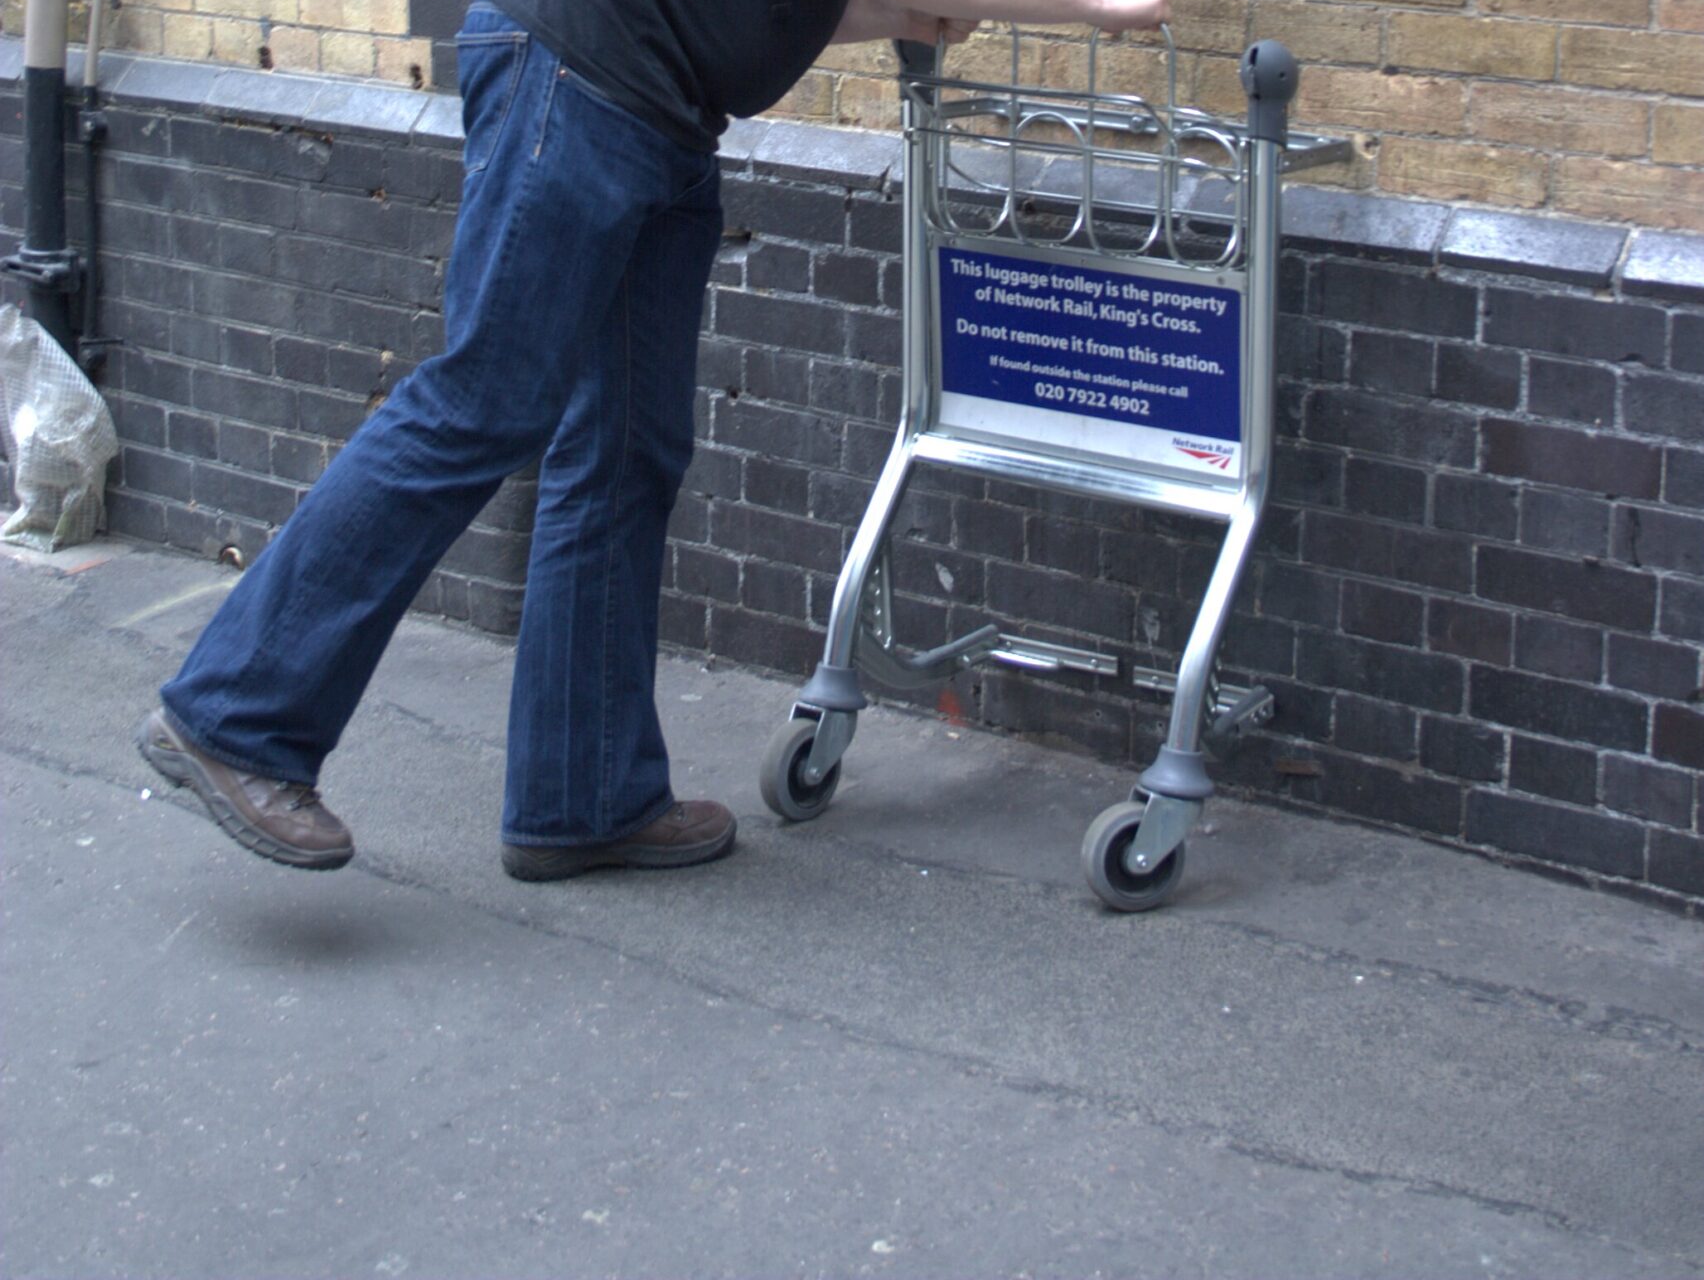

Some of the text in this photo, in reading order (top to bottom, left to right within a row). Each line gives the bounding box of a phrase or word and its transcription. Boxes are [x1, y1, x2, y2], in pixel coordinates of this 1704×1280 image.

[950, 258, 1227, 316] This luggage trolley is the property
[975, 285, 1202, 333] of Network Rail, King's Cross.
[956, 318, 1225, 375] Do not remove it from this station.
[989, 355, 1189, 398] If found outside the station please call
[1034, 382, 1151, 415] 020 7922 4902
[1172, 437, 1234, 455] Network Rail
